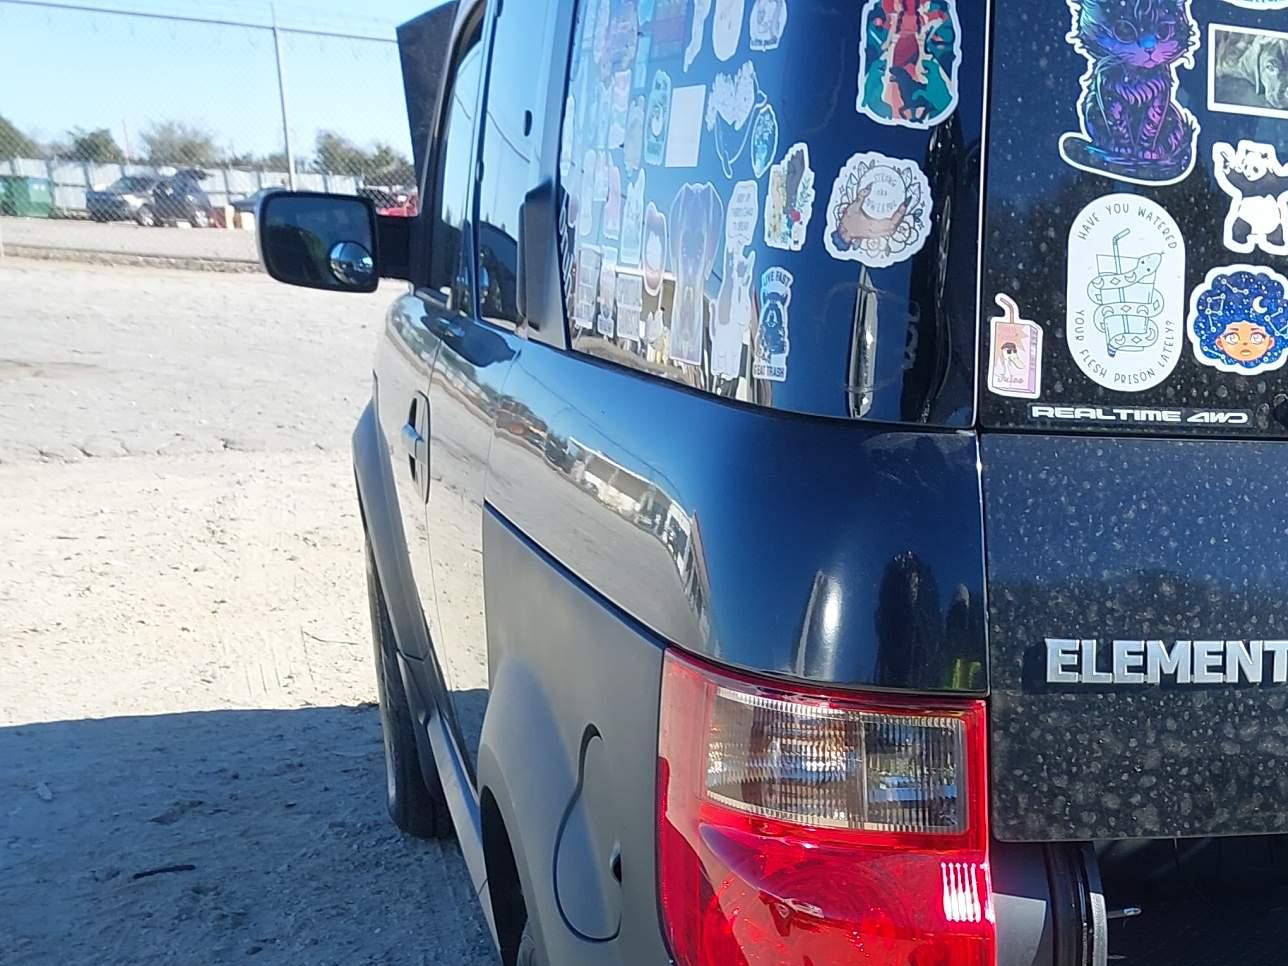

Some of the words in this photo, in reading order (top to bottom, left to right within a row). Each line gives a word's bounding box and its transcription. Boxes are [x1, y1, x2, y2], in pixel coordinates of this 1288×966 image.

[1077, 211, 1101, 241] HAVE
[1105, 202, 1130, 216] YOU
[1137, 205, 1178, 250] WATERED
[1074, 309, 1085, 342] YOUR
[1157, 320, 1176, 368] LATELY?
[1079, 348, 1109, 379] FLESH
[1113, 369, 1156, 385] PRISON
[1031, 406, 1181, 422] REALTIME
